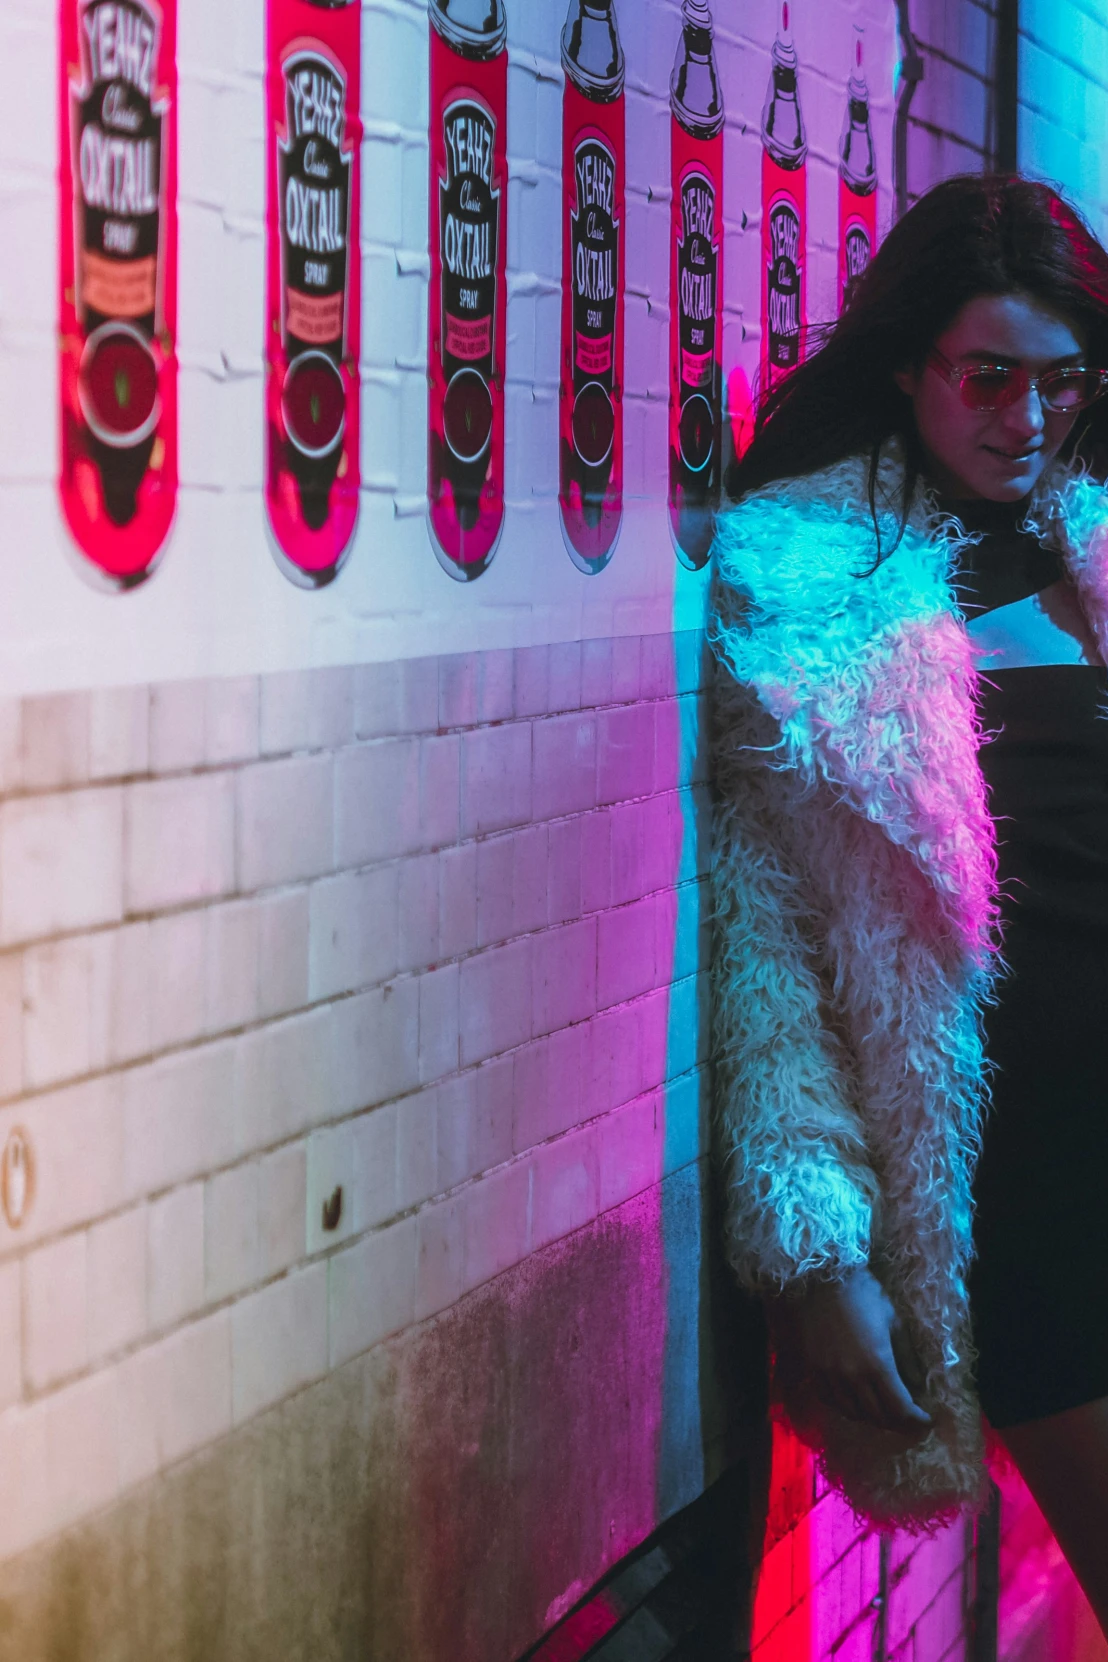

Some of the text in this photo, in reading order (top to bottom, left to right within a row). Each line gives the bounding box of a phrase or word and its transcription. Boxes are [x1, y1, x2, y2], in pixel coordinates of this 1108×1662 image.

[80, 123, 158, 215] OXTAIL
[286, 177, 343, 252] OXTAIL
[459, 179, 481, 213] Classic
[445, 213, 490, 279] OXTAIL
[586, 211, 605, 241] Classic
[304, 260, 329, 286] SPRAY
[576, 242, 614, 301] OXTAIL
[681, 267, 713, 321] OXTAIL
[459, 288, 478, 309] SPRAY
[586, 309, 602, 329] SPRAY
[769, 287, 799, 337] OXTAIL
